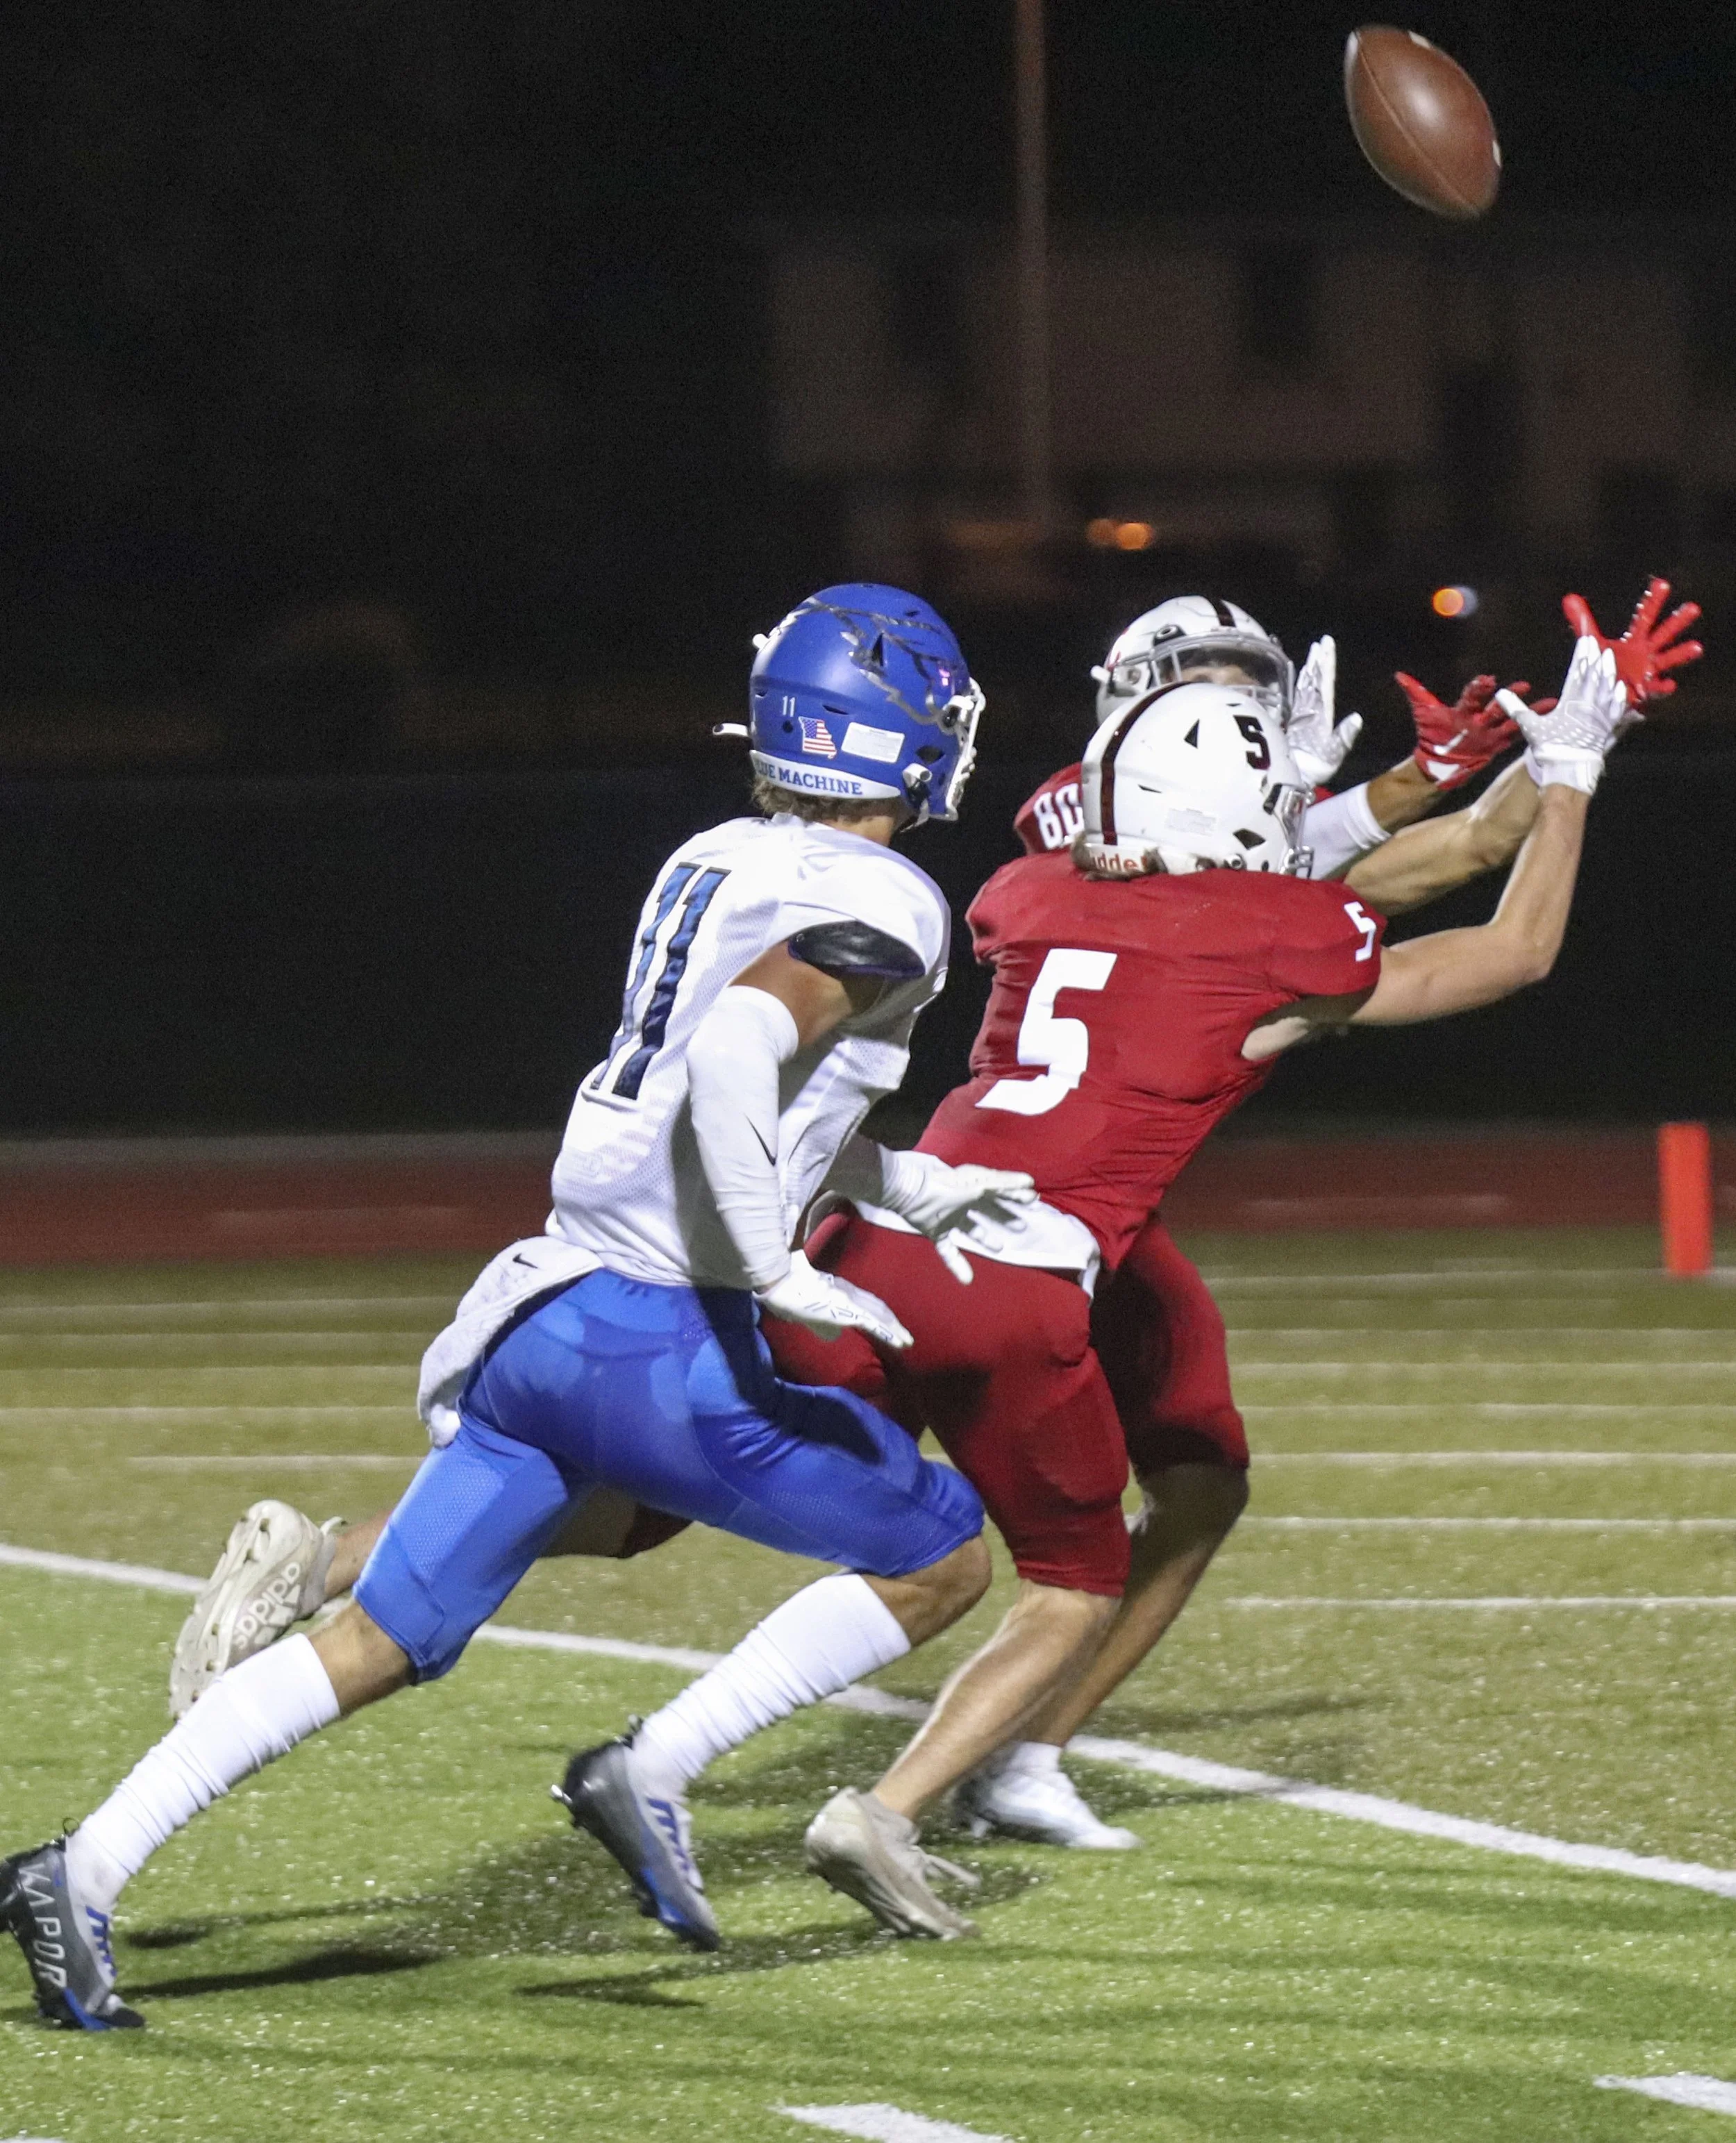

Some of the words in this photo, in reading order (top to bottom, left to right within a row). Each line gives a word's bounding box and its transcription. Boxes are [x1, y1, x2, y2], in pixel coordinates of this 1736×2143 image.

[783, 695, 796, 717] 11
[1233, 715, 1271, 770] S
[778, 767, 863, 795] MACHINE
[1033, 783, 1085, 850] 80
[1343, 901, 1376, 962] 5
[588, 862, 731, 1100] 11
[975, 948, 1117, 1116] 5
[18, 1863, 67, 1987] VAPOR
